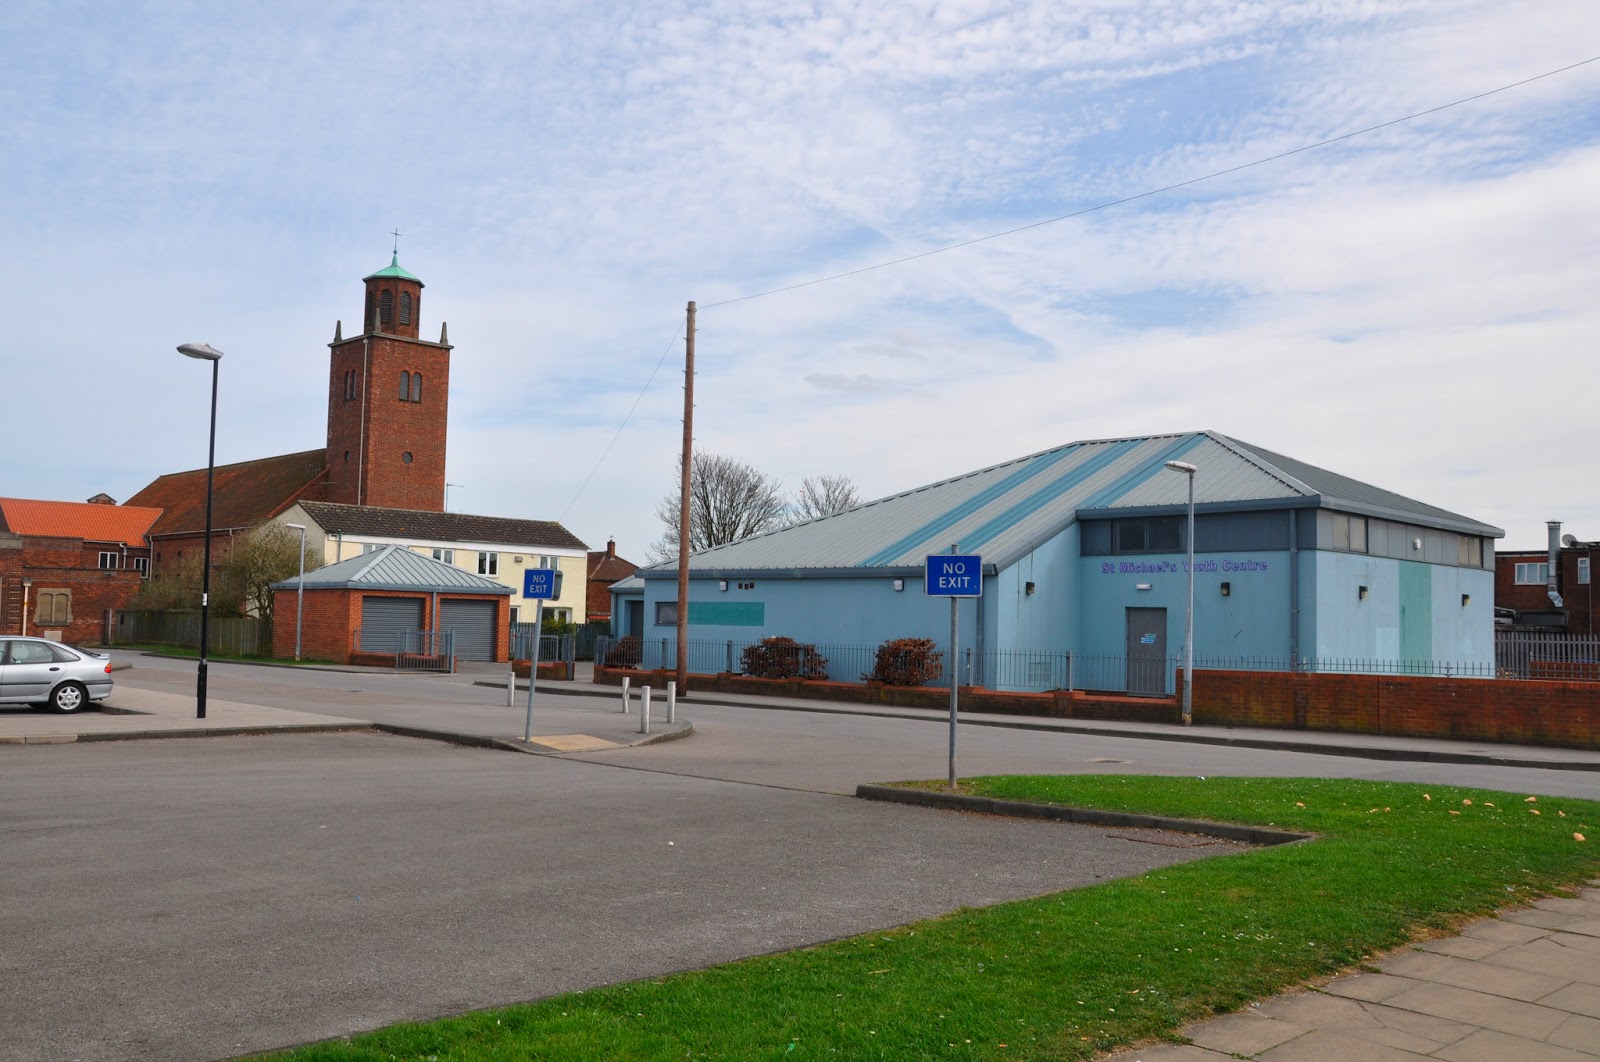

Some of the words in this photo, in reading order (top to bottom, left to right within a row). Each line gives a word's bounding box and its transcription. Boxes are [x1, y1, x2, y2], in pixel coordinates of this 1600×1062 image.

[943, 562, 966, 574] NO
[1102, 562, 1115, 573] St
[1120, 561, 1177, 573] Michael's
[1222, 559, 1268, 572] Centre
[532, 574, 546, 583] NO
[939, 576, 971, 588] EXIT
[529, 585, 547, 593] EXIT
